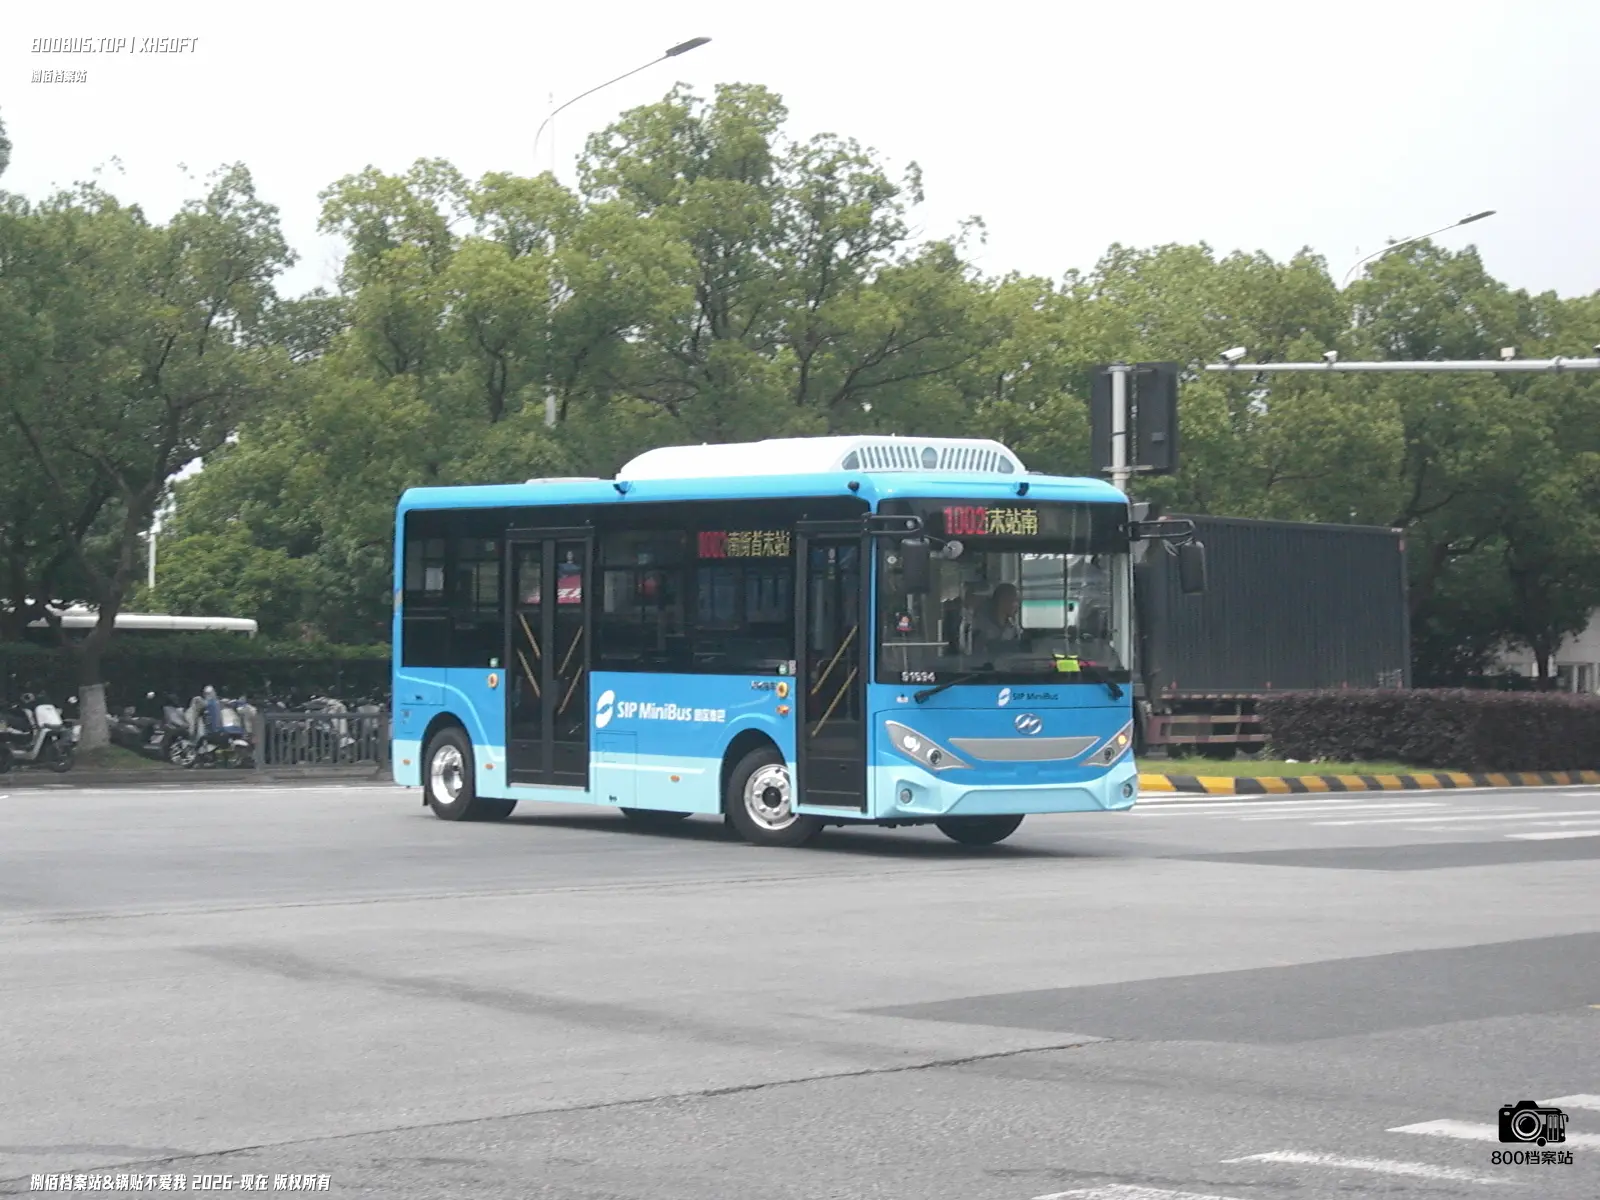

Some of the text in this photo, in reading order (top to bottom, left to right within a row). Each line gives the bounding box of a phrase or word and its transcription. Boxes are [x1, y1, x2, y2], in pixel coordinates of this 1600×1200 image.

[943, 505, 1038, 535] 1002 末站南
[616, 701, 638, 719] SIP
[639, 702, 692, 721] MiniBus
